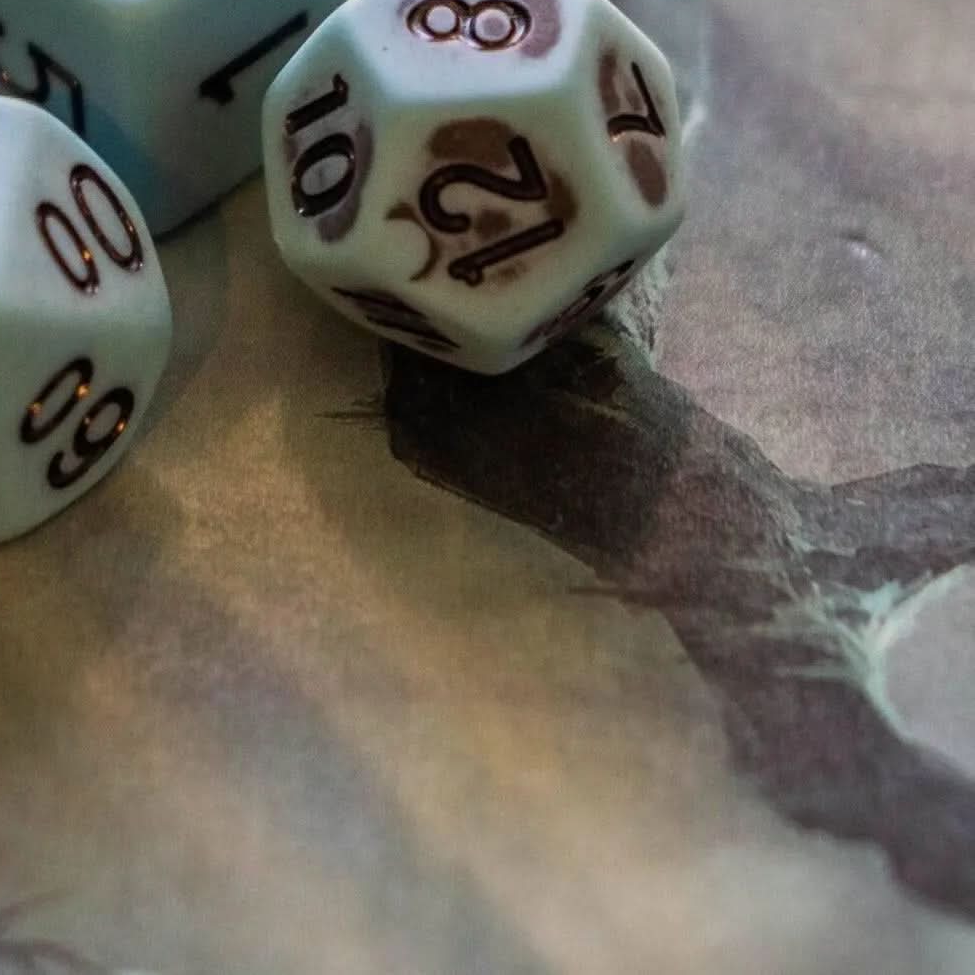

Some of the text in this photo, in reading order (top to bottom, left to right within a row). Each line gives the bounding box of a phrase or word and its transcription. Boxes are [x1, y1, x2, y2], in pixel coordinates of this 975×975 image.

[198, 11, 309, 106] 1
[285, 72, 355, 218] 10
[419, 134, 566, 287] 12
[35, 163, 144, 296] 00
